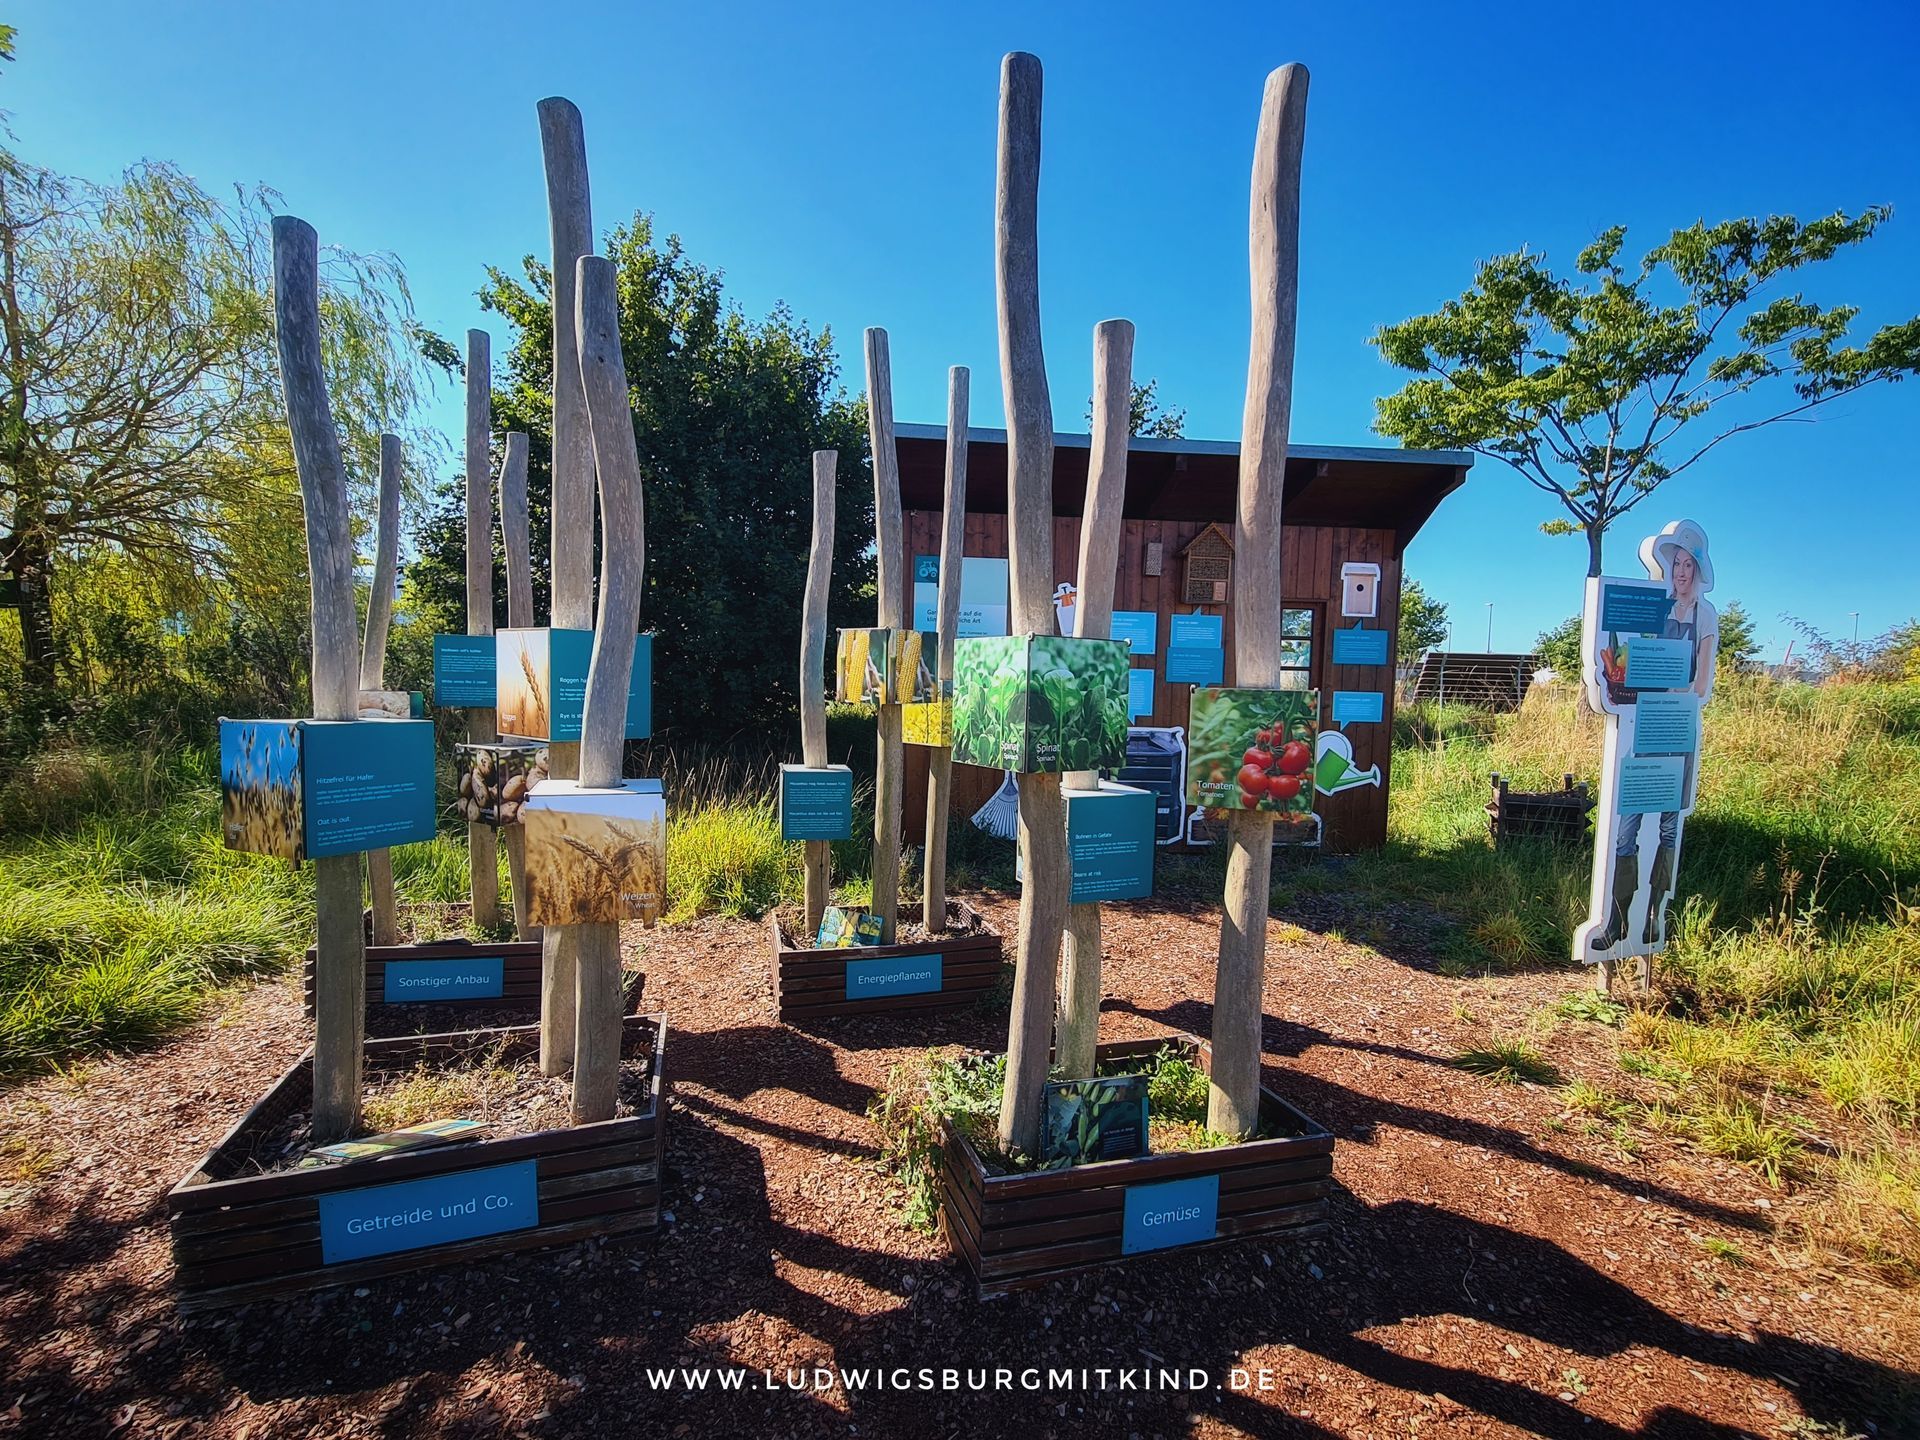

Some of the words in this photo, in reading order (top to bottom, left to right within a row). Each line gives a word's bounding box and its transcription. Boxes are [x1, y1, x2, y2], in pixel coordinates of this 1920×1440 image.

[1036, 743, 1061, 754] Spinat
[1197, 780, 1235, 790] Tomaten
[1197, 790, 1225, 798] Tomatoes
[317, 818, 330, 826] Oat
[622, 892, 655, 901] Weizen
[398, 976, 452, 988] Sonstiger
[454, 974, 490, 985] Anbau
[857, 971, 932, 985] Energiepflanzen
[346, 1208, 433, 1235] Getreide
[440, 1198, 476, 1219] und
[483, 1194, 514, 1211] Co.
[1142, 1206, 1201, 1227] Gemüse
